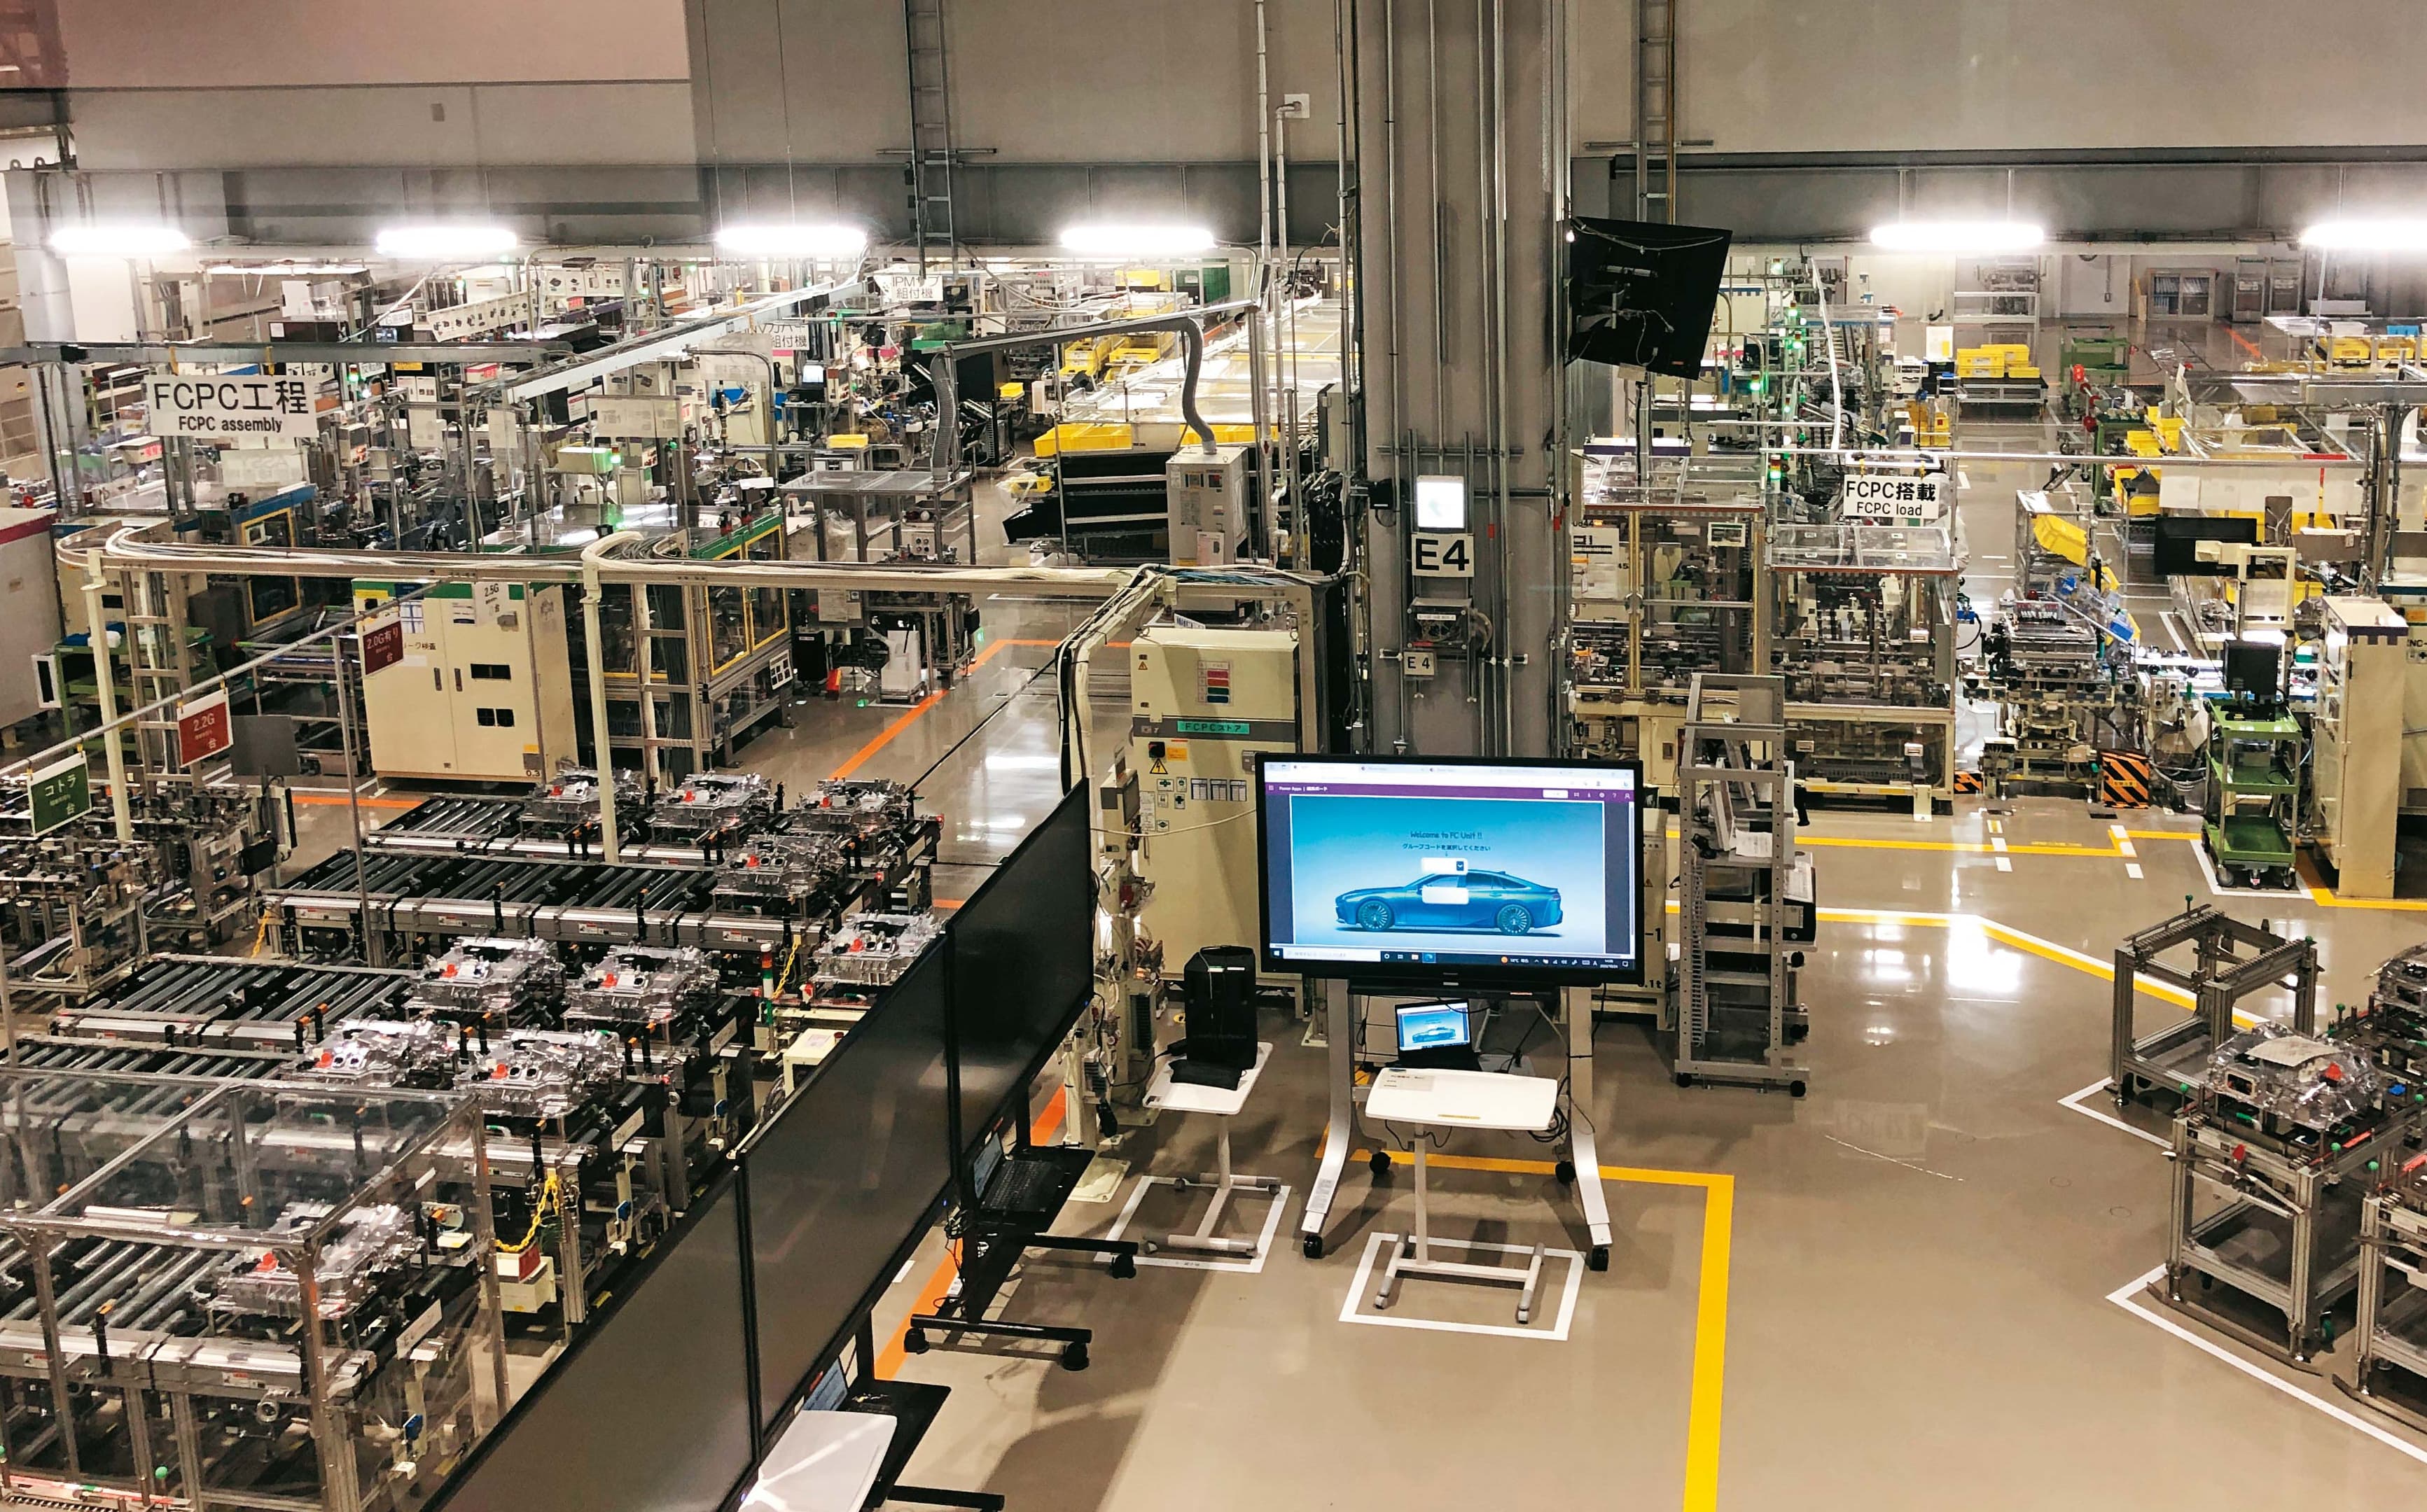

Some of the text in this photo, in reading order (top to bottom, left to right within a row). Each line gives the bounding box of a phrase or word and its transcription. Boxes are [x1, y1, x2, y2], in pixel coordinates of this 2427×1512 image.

[896, 288, 933, 298] 組付機
[153, 380, 309, 414] FCPC工程
[179, 416, 282, 433] FCPC assembly
[1846, 481, 1936, 502] FCPC搭載
[1857, 502, 1923, 516] FCPC load
[1415, 538, 1470, 571] E4
[367, 626, 398, 650] 2.0G有り
[193, 713, 215, 732] 2.2G
[1185, 722, 1242, 732] FCPCストア
[45, 774, 76, 797] コトラ
[1461, 832, 1475, 840] Unit
